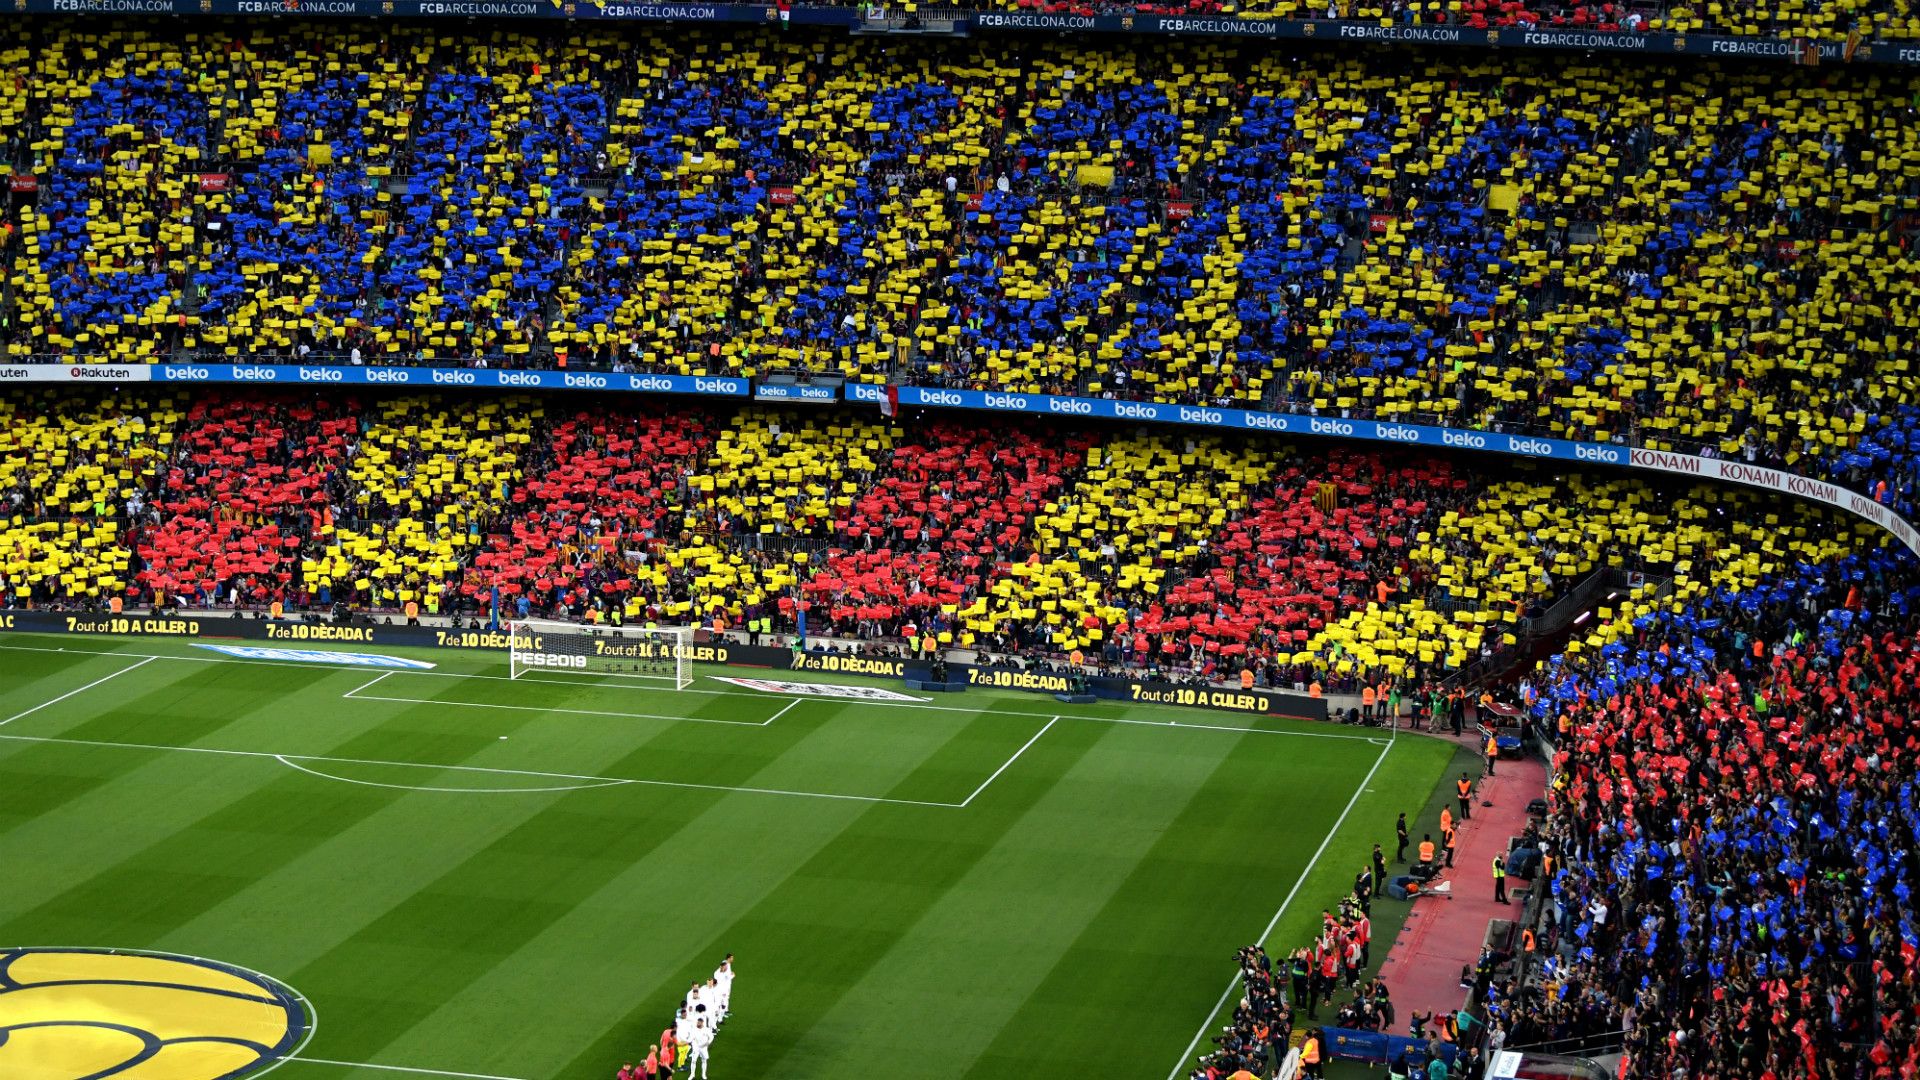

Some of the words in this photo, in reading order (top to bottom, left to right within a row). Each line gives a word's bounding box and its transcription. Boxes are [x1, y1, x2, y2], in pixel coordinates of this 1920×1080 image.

[53, 0, 173, 11] FCBARCELONA.COM
[419, 3, 537, 14] FCBARCELONA.COM
[600, 6, 715, 18] FCBARCELONA.COM
[979, 15, 1095, 28] FCBARCELONA.COM
[1159, 19, 1276, 33] FCBARCELONA.COM
[1341, 26, 1459, 41] FCBARCELONA.COM
[1524, 33, 1645, 48] FCBARCELONA.COM
[0, 368, 28, 378] uten
[81, 367, 130, 378] Rakuten
[165, 366, 208, 379] beko
[232, 366, 275, 380] beko
[299, 367, 342, 381] beko
[366, 368, 409, 382] beko
[432, 370, 475, 383] beko
[498, 371, 541, 385] beko
[564, 373, 607, 387] beko
[629, 375, 672, 390] beko
[695, 378, 737, 393] beko
[760, 387, 787, 396] beko
[801, 388, 828, 397] beko
[920, 389, 962, 405] beko
[984, 393, 1026, 409] beko
[1049, 398, 1091, 413] beko
[1114, 402, 1157, 418] beko
[1180, 407, 1222, 423] beko
[1245, 413, 1287, 429] beko
[1310, 418, 1353, 435] beko
[1376, 424, 1419, 441] beko
[1442, 430, 1485, 448] beko
[1509, 437, 1552, 455] beko
[1575, 443, 1618, 462] beko
[1630, 449, 1700, 472] KONAMI
[1720, 463, 1780, 487] KONAMI
[1788, 476, 1837, 502] KONAMI
[1850, 495, 1883, 523] KONAMI
[66, 617, 77, 632] 7
[76, 621, 95, 632] out
[98, 621, 109, 633] of
[111, 619, 129, 633] 10
[131, 620, 141, 633] A
[145, 620, 186, 634] CULER
[189, 621, 199, 634] D
[266, 623, 276, 638] 7
[276, 626, 290, 638] de
[291, 624, 308, 639] 10
[366, 628, 373, 641] C
[436, 631, 446, 646] 7
[446, 634, 460, 646] de
[461, 633, 478, 647] 10
[535, 636, 542, 650] C
[595, 640, 605, 655] 7
[605, 645, 623, 656] out
[626, 645, 637, 656] of
[660, 645, 669, 658] A
[717, 648, 728, 662] D
[513, 652, 587, 667] PES2019
[798, 654, 806, 668] 7
[806, 657, 820, 669] de
[821, 655, 839, 670] 10
[896, 663, 904, 676] C
[968, 668, 979, 684] 7
[978, 672, 992, 685] de
[993, 671, 1012, 687] 10
[1131, 684, 1142, 700] 7
[1141, 691, 1160, 702] out
[1163, 690, 1175, 702] of
[1176, 689, 1195, 704] 10
[1197, 692, 1208, 705] A
[1211, 693, 1255, 710] CULER
[1258, 697, 1269, 711] D
